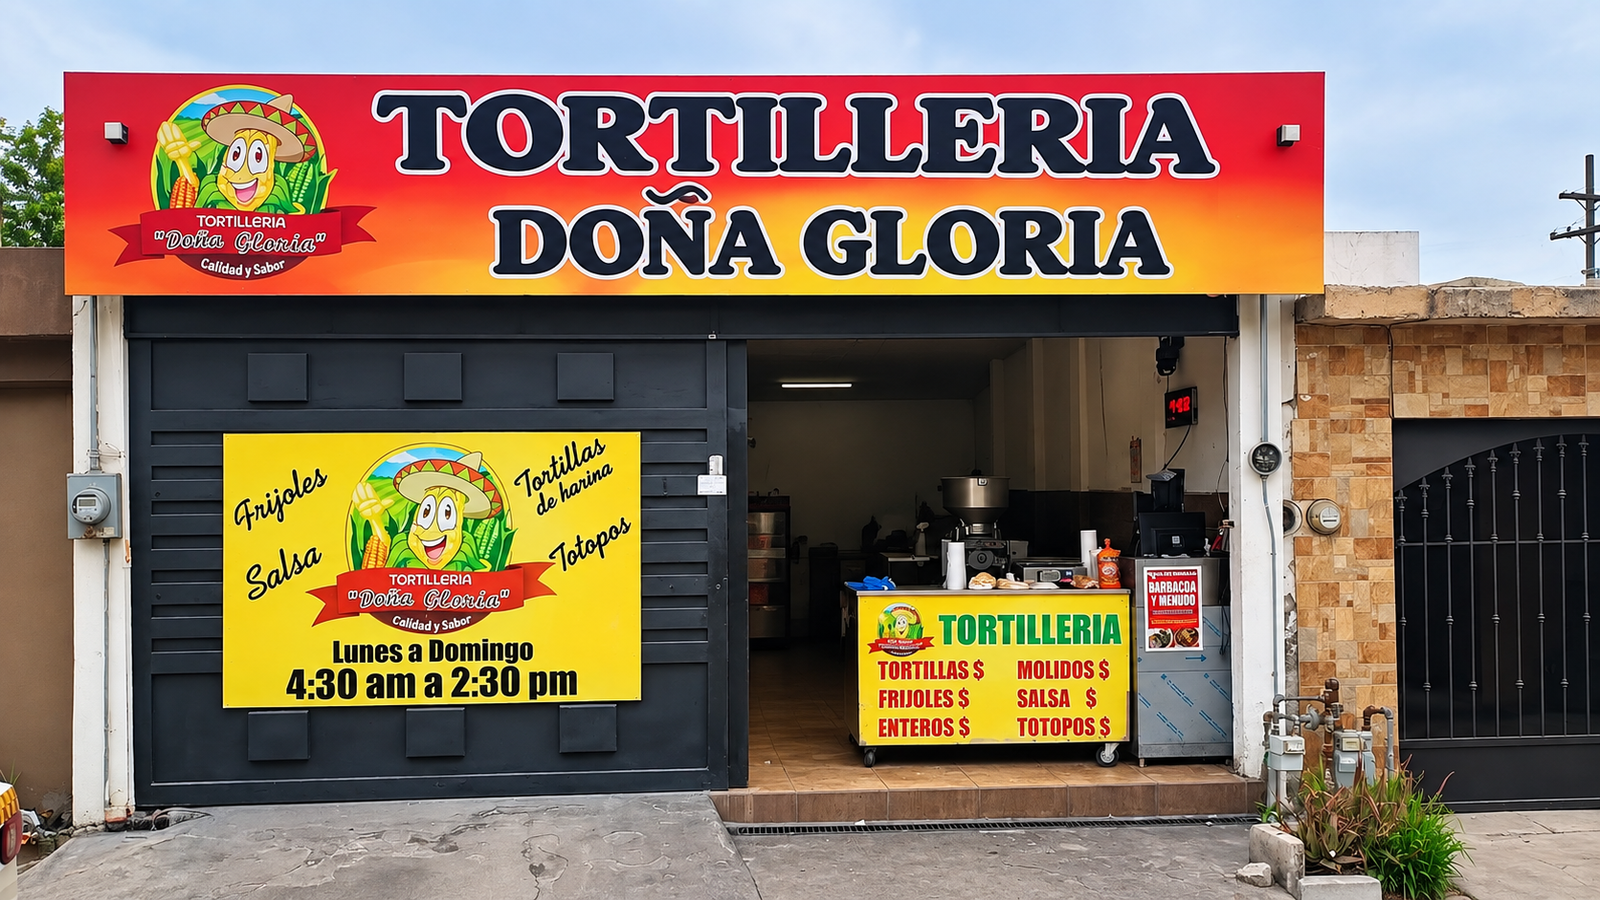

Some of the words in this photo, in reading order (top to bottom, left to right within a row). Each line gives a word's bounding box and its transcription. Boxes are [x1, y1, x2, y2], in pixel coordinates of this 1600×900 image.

[371, 89, 1220, 179] TORTILLERIA
[196, 215, 286, 228] TORTILLERIA
[489, 182, 785, 280] DOÑA
[801, 206, 1174, 280] GLORIA
[234, 232, 326, 254] Gloria"
[245, 266, 251, 278] y
[253, 259, 286, 276] Sabor
[514, 437, 606, 500] Tortillas
[233, 468, 328, 532] Frijoles
[535, 496, 558, 517] de
[561, 462, 614, 502] harina
[549, 516, 632, 573] Totopos
[245, 544, 322, 600] Salsa
[389, 574, 472, 586] TORTILLERIA
[1148, 580, 1197, 593] BARBACOA
[423, 588, 510, 611] Gloria"
[1151, 595, 1157, 606] Y
[1159, 594, 1196, 606] MENUDO
[434, 622, 439, 634] y
[442, 616, 472, 631] Sabor
[938, 614, 1122, 645] TORTILLERIA
[332, 640, 402, 664] Lunes
[408, 646, 423, 662] a
[428, 639, 534, 663] Domingo
[877, 660, 969, 680] TORTILLAS
[973, 659, 985, 681] $
[1017, 660, 1095, 680] MOLIDOS
[1098, 658, 1110, 681] $
[285, 668, 358, 701] 4:30
[365, 673, 417, 699] am
[424, 672, 443, 698] a
[450, 666, 520, 698] 2:30
[529, 668, 578, 701] pm
[878, 688, 954, 709] FRIJOLES
[958, 687, 970, 709] $
[1017, 688, 1070, 708] SALSA
[1085, 687, 1097, 709] $
[878, 717, 954, 738] ENTEROS
[958, 716, 970, 738] $
[1017, 717, 1095, 737] TOTOPOS
[1099, 716, 1111, 738] $
